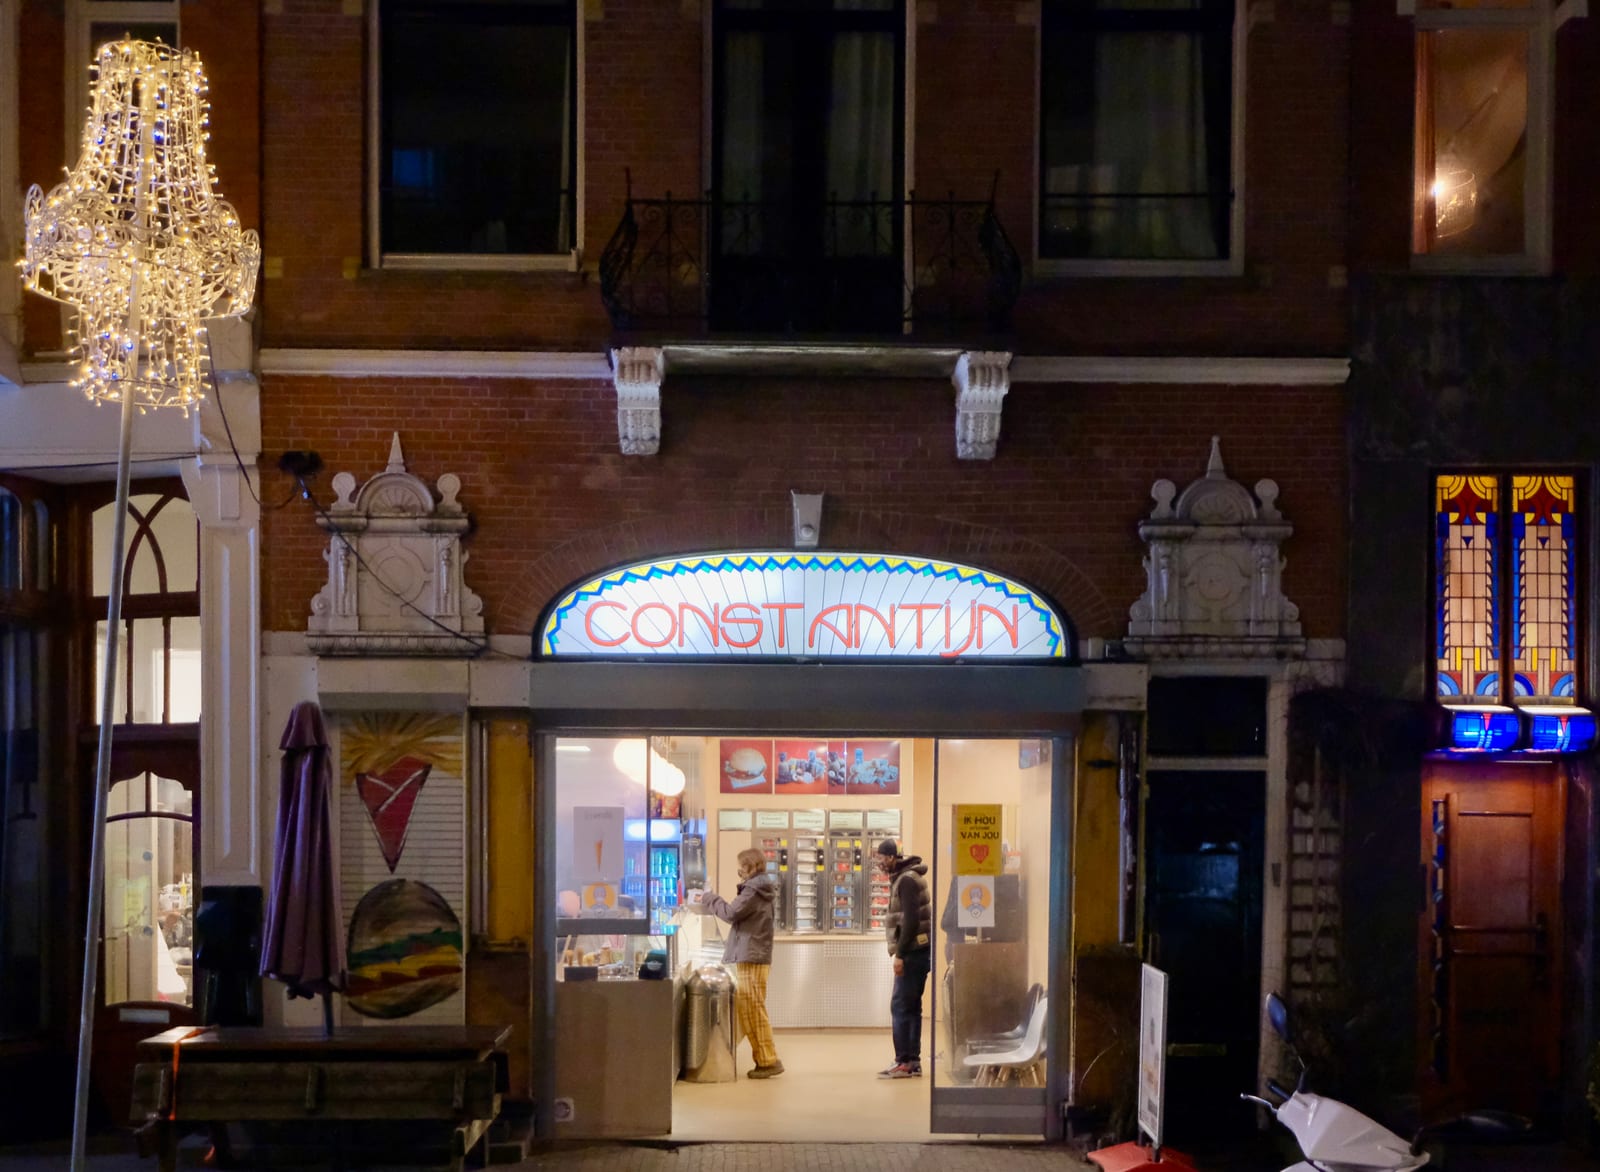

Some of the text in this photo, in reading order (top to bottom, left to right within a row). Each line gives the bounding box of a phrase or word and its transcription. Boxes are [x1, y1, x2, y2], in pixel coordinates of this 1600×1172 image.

[584, 599, 1018, 657] CONSTANTIJN
[963, 815, 996, 825] IK HOU
[960, 831, 999, 840] VAN JOU
